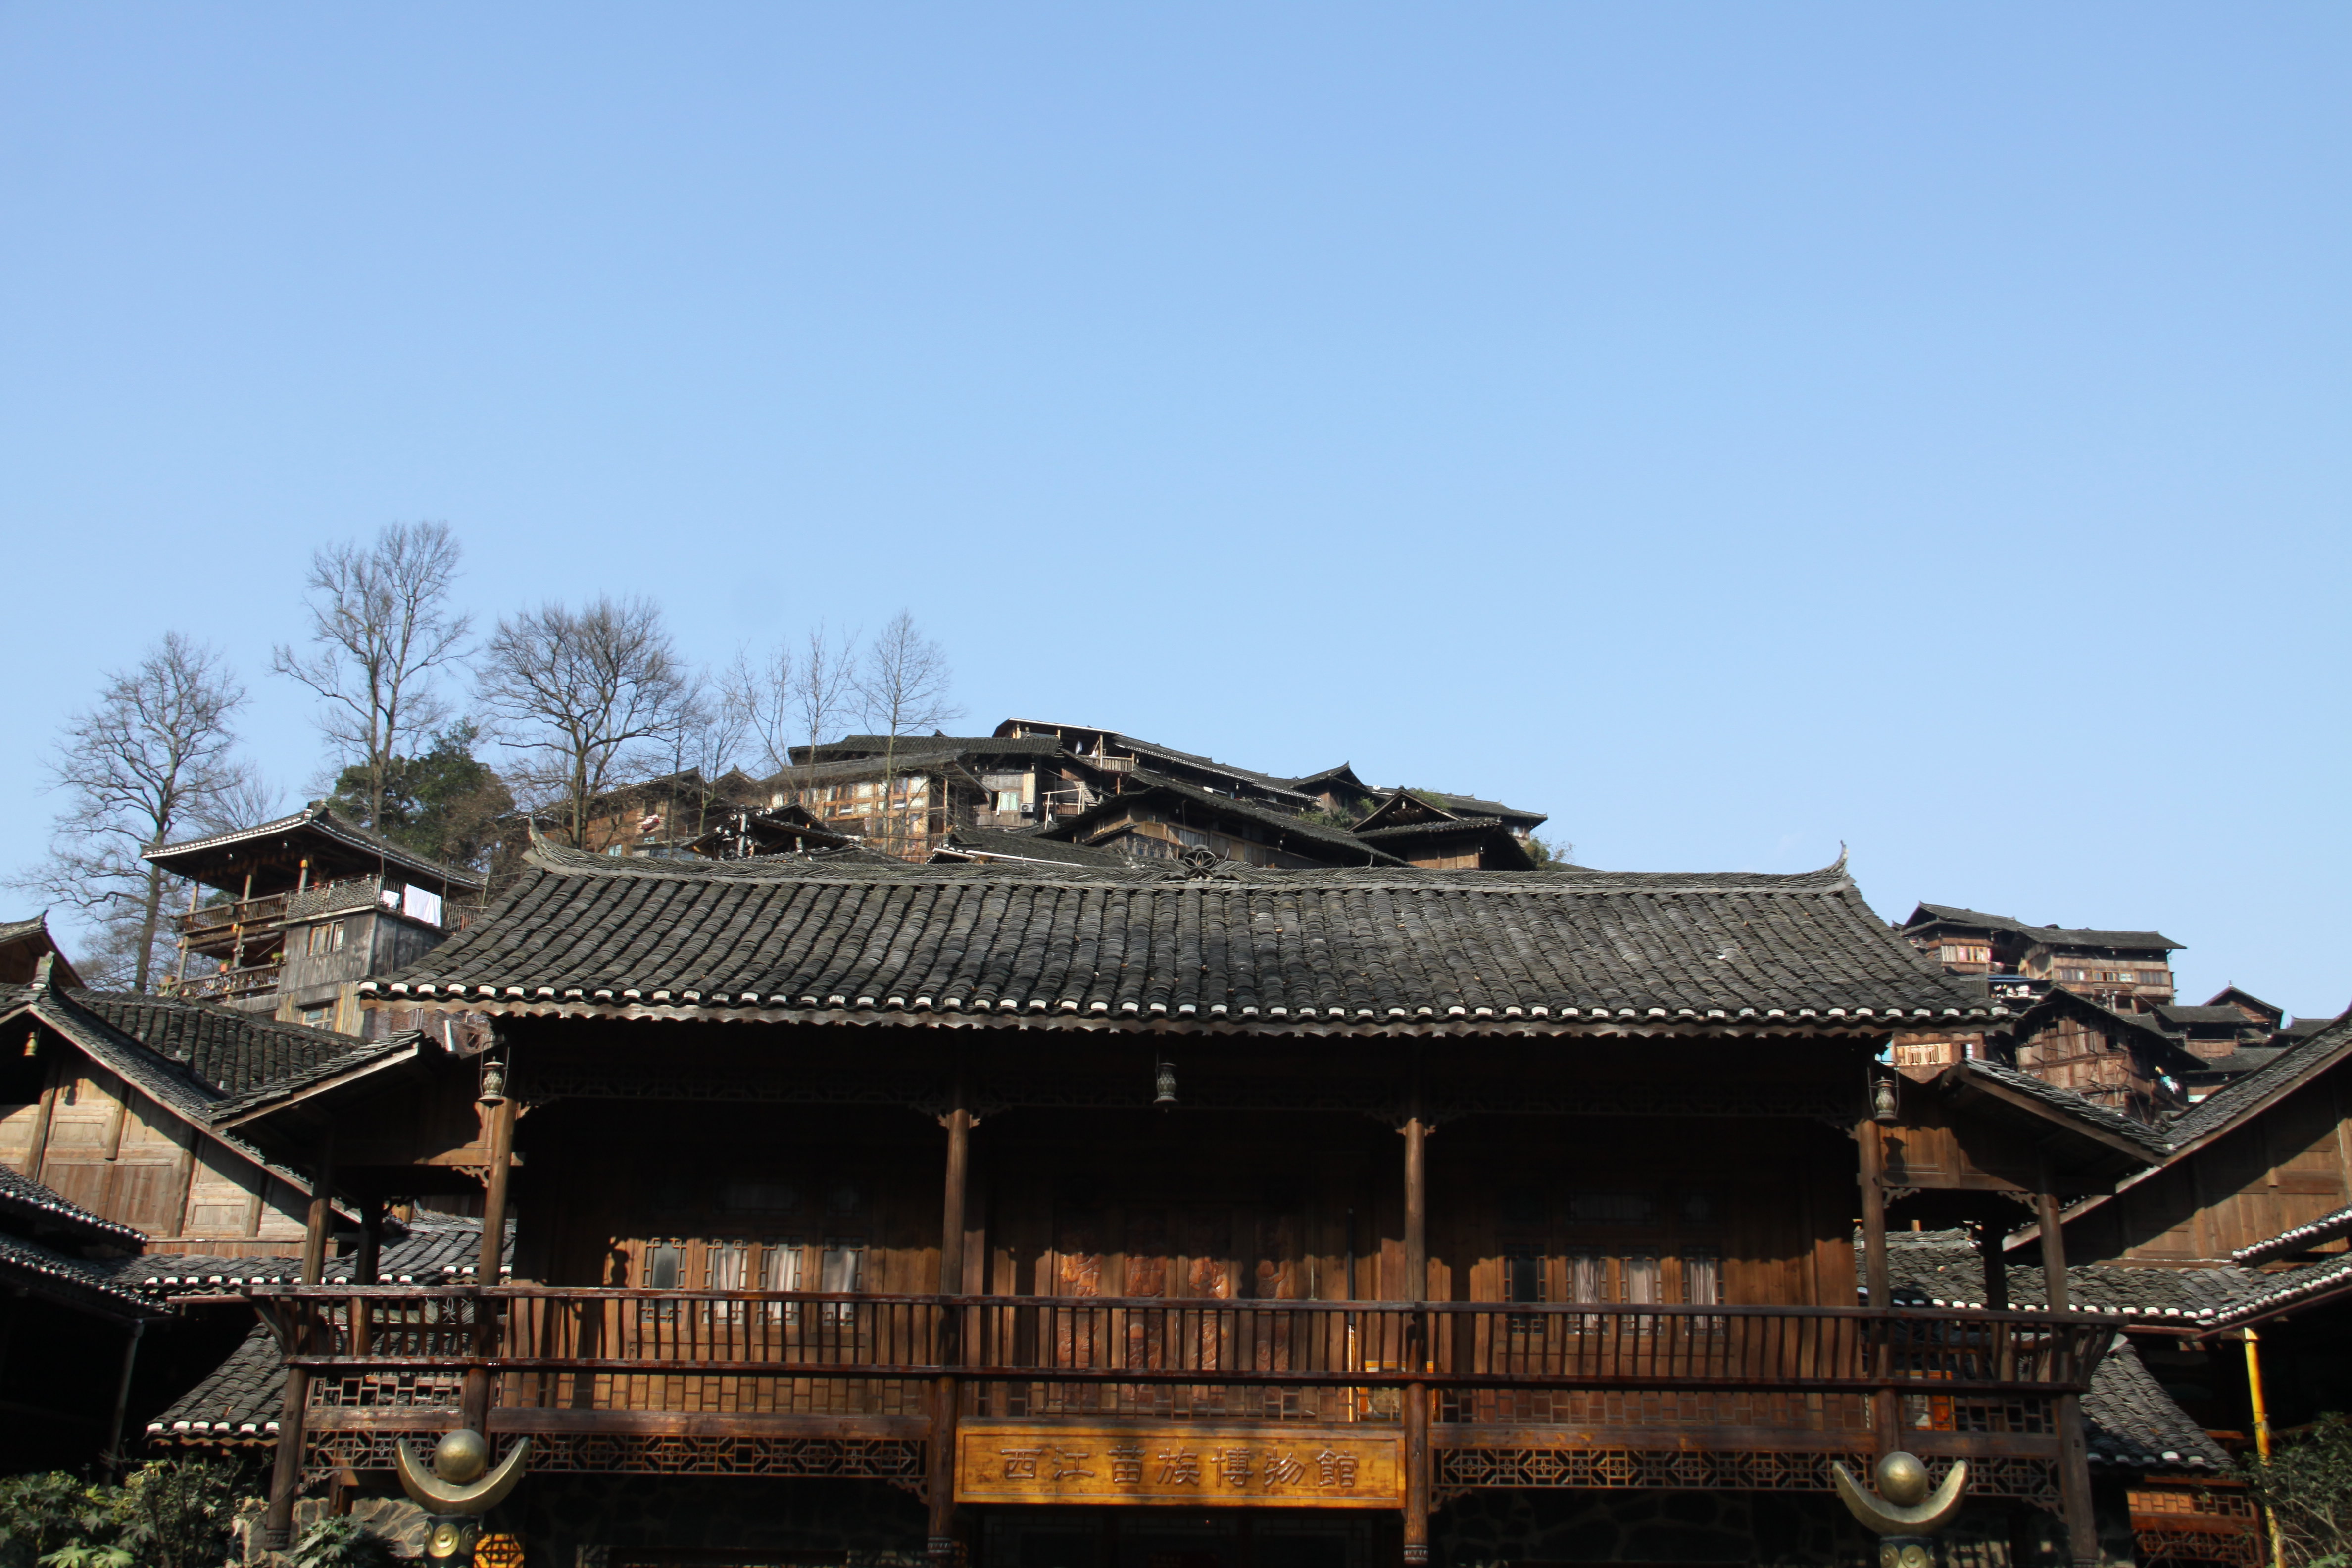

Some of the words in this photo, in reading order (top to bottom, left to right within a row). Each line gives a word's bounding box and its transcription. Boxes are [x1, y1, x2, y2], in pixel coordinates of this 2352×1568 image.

[1000, 1445, 1359, 1488] 西江苗族博物館
